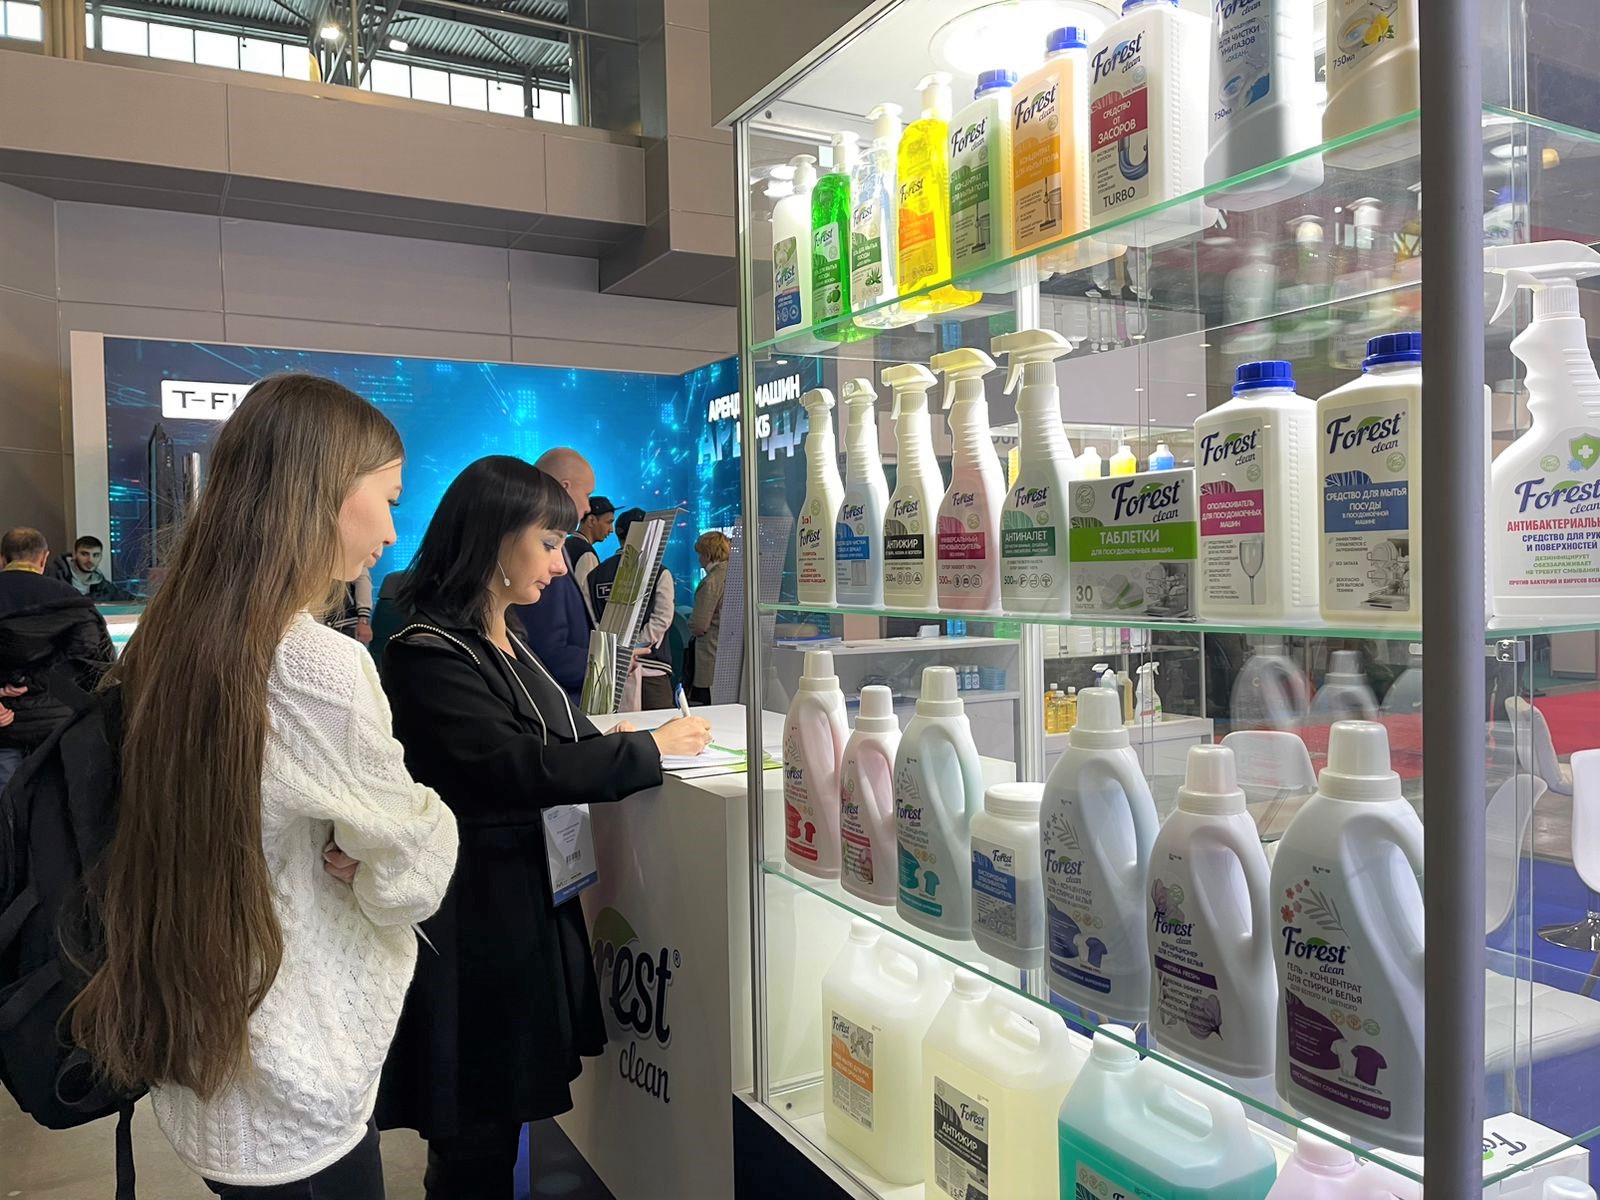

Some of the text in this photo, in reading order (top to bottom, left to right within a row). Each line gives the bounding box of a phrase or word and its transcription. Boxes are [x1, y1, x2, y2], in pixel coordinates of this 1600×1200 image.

[1231, 24, 1261, 42] ЧИСТКИ
[1220, 35, 1256, 57] УНИТАЗОВ
[1091, 34, 1143, 84] Forest
[1014, 85, 1057, 130] Forest
[1103, 100, 1132, 121] СРЕДСТВО
[1112, 115, 1121, 126] ОТ
[951, 118, 986, 158] Forest
[1098, 118, 1137, 145] ЗАСОРОВ
[1103, 187, 1136, 209] TURBO
[708, 391, 742, 422] АРЕНД
[1326, 413, 1402, 454] Forest
[1200, 430, 1257, 466] Forest
[1371, 439, 1399, 454] clean
[1235, 453, 1256, 466] clean
[1015, 487, 1047, 508] Forest
[1111, 479, 1180, 521] Forest
[1326, 487, 1407, 502] СРЕДСТВО ДЛЯ МЫТЬЯ
[1514, 477, 1600, 513] Forest
[1152, 509, 1178, 523] clean
[1349, 501, 1382, 511] ПОСУДЫ
[1570, 502, 1600, 515] clean
[886, 538, 919, 550] АНТИЖИР
[1004, 530, 1047, 542] АНТИНАЛЕТ
[1100, 529, 1160, 545] ТАБЛЕТКИ
[1522, 533, 1564, 543] СРЕДСТВО
[1566, 532, 1584, 542] ДЛЯ
[1526, 541, 1597, 552] И ПОВЕРХНОСТЕЙ
[1533, 560, 1591, 568] ОБЕЗЗАРАЖИВАЕТ
[1534, 553, 1590, 562] ДЕЗИНФИЦИРУЕТ
[1076, 585, 1093, 602] 30
[1044, 848, 1082, 876] Forest
[1153, 908, 1192, 937] Forest
[1282, 926, 1346, 964] Forest
[1287, 962, 1303, 975] ГЕЛЬ
[1310, 971, 1362, 993] КОНЦЕНТРАТ
[1319, 963, 1345, 976] clean
[592, 939, 672, 1043] rest
[1287, 972, 1363, 1005] ДЛЯ СТИРКИ БЕЛЬЯ
[620, 1041, 670, 1103] clean
[941, 1121, 978, 1151] АНТИЖИР
